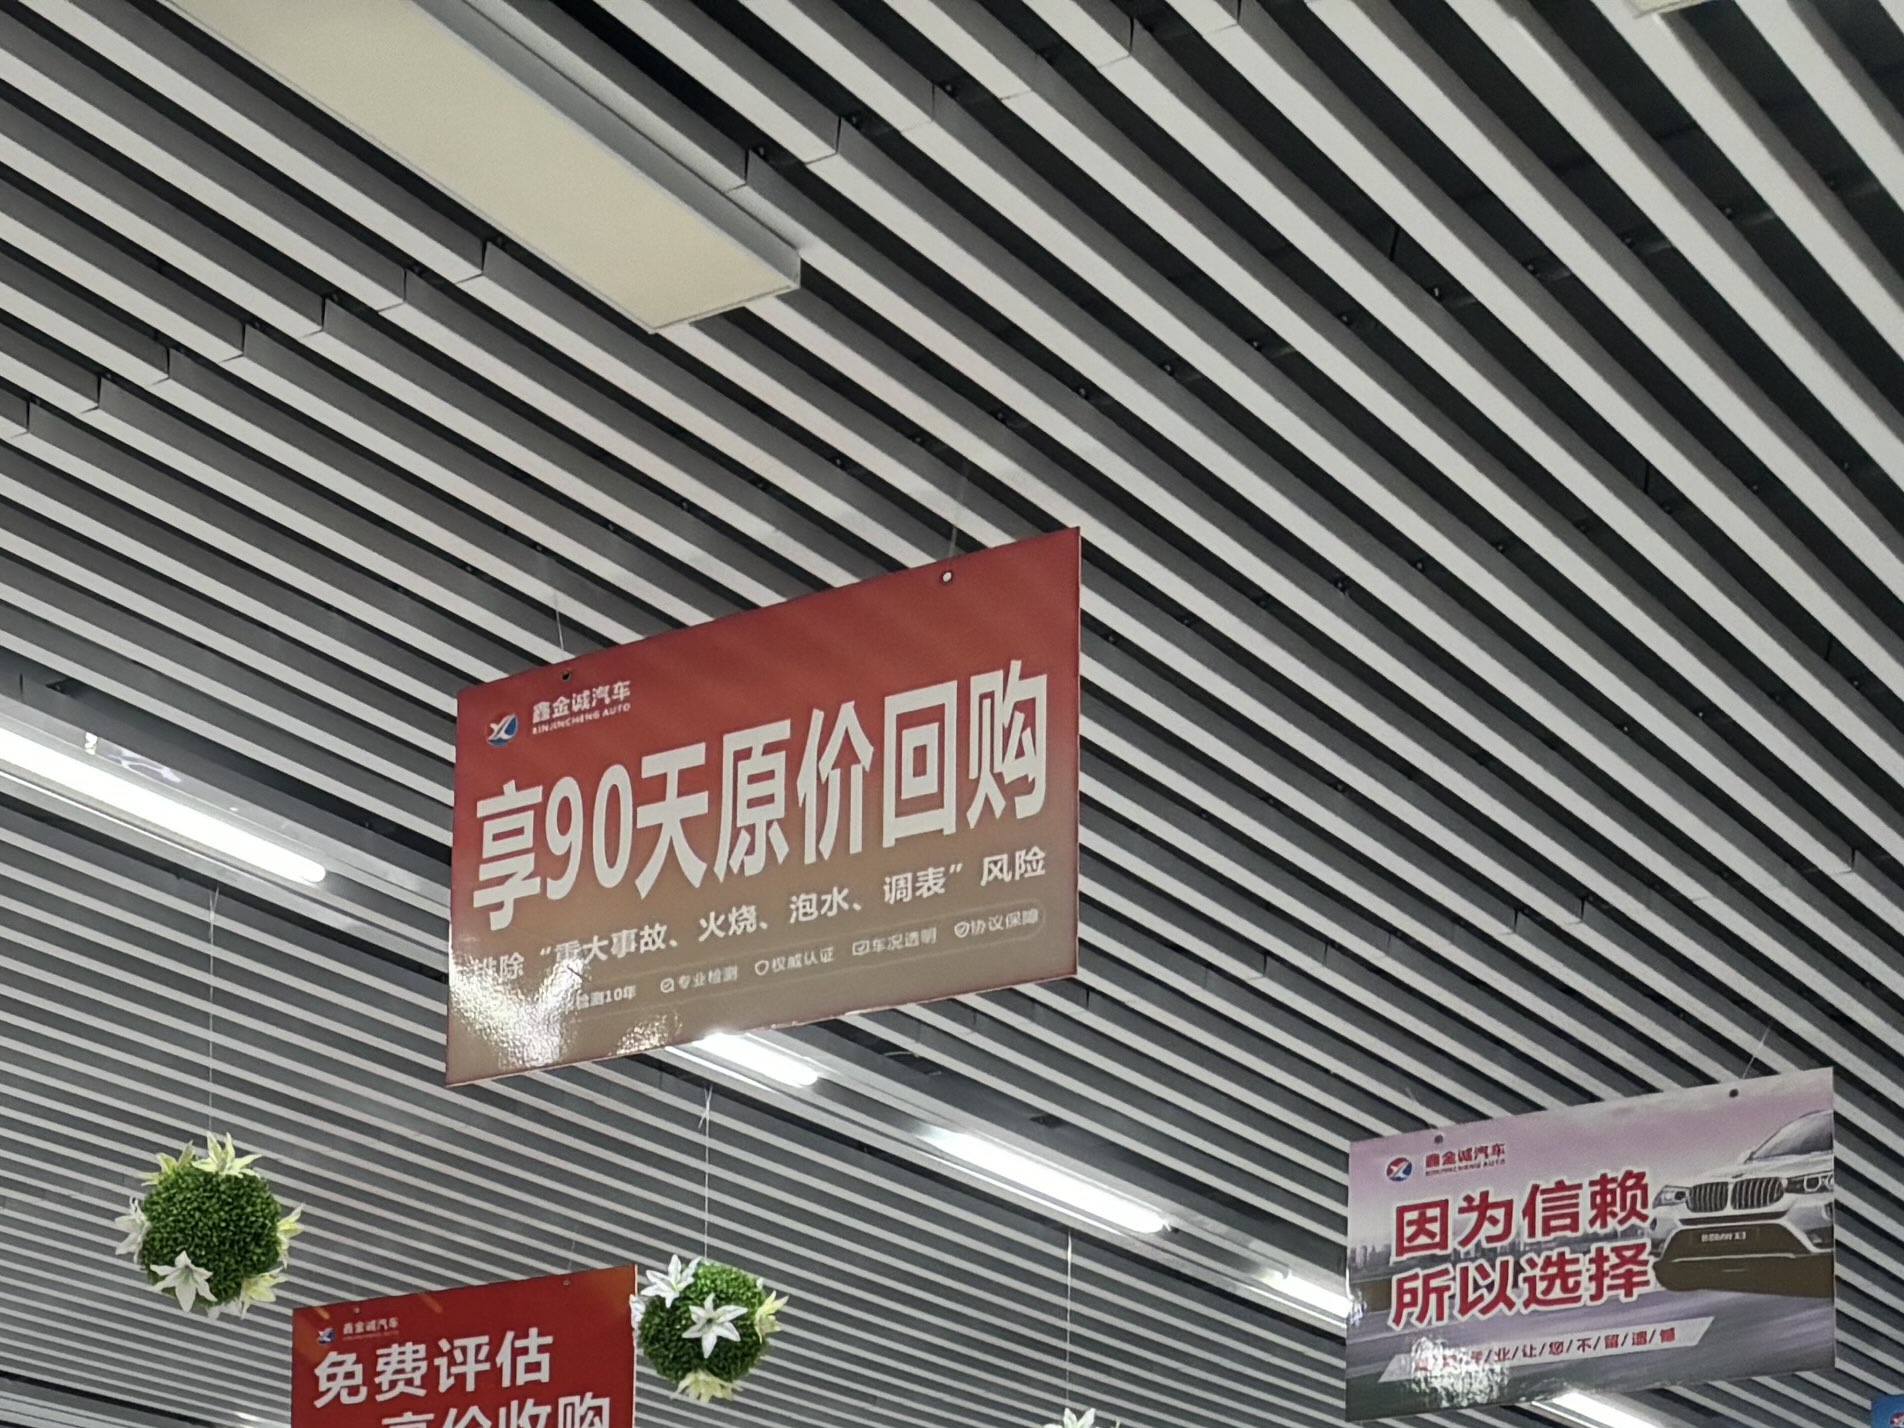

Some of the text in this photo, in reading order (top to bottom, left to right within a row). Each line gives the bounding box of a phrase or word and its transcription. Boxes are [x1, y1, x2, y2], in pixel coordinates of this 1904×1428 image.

[532, 680, 631, 724] 鑫金诚汽车
[472, 659, 1049, 932] 享90天原价回购
[678, 965, 739, 990] 专业检测
[772, 946, 834, 973] 权威认证
[871, 928, 937, 953] 车况透明
[970, 909, 1040, 935] 协议保障
[1395, 1168, 1650, 1257] 因为信赖
[1389, 1241, 1651, 1327] 所以选择
[313, 1327, 554, 1408] 免费评估
